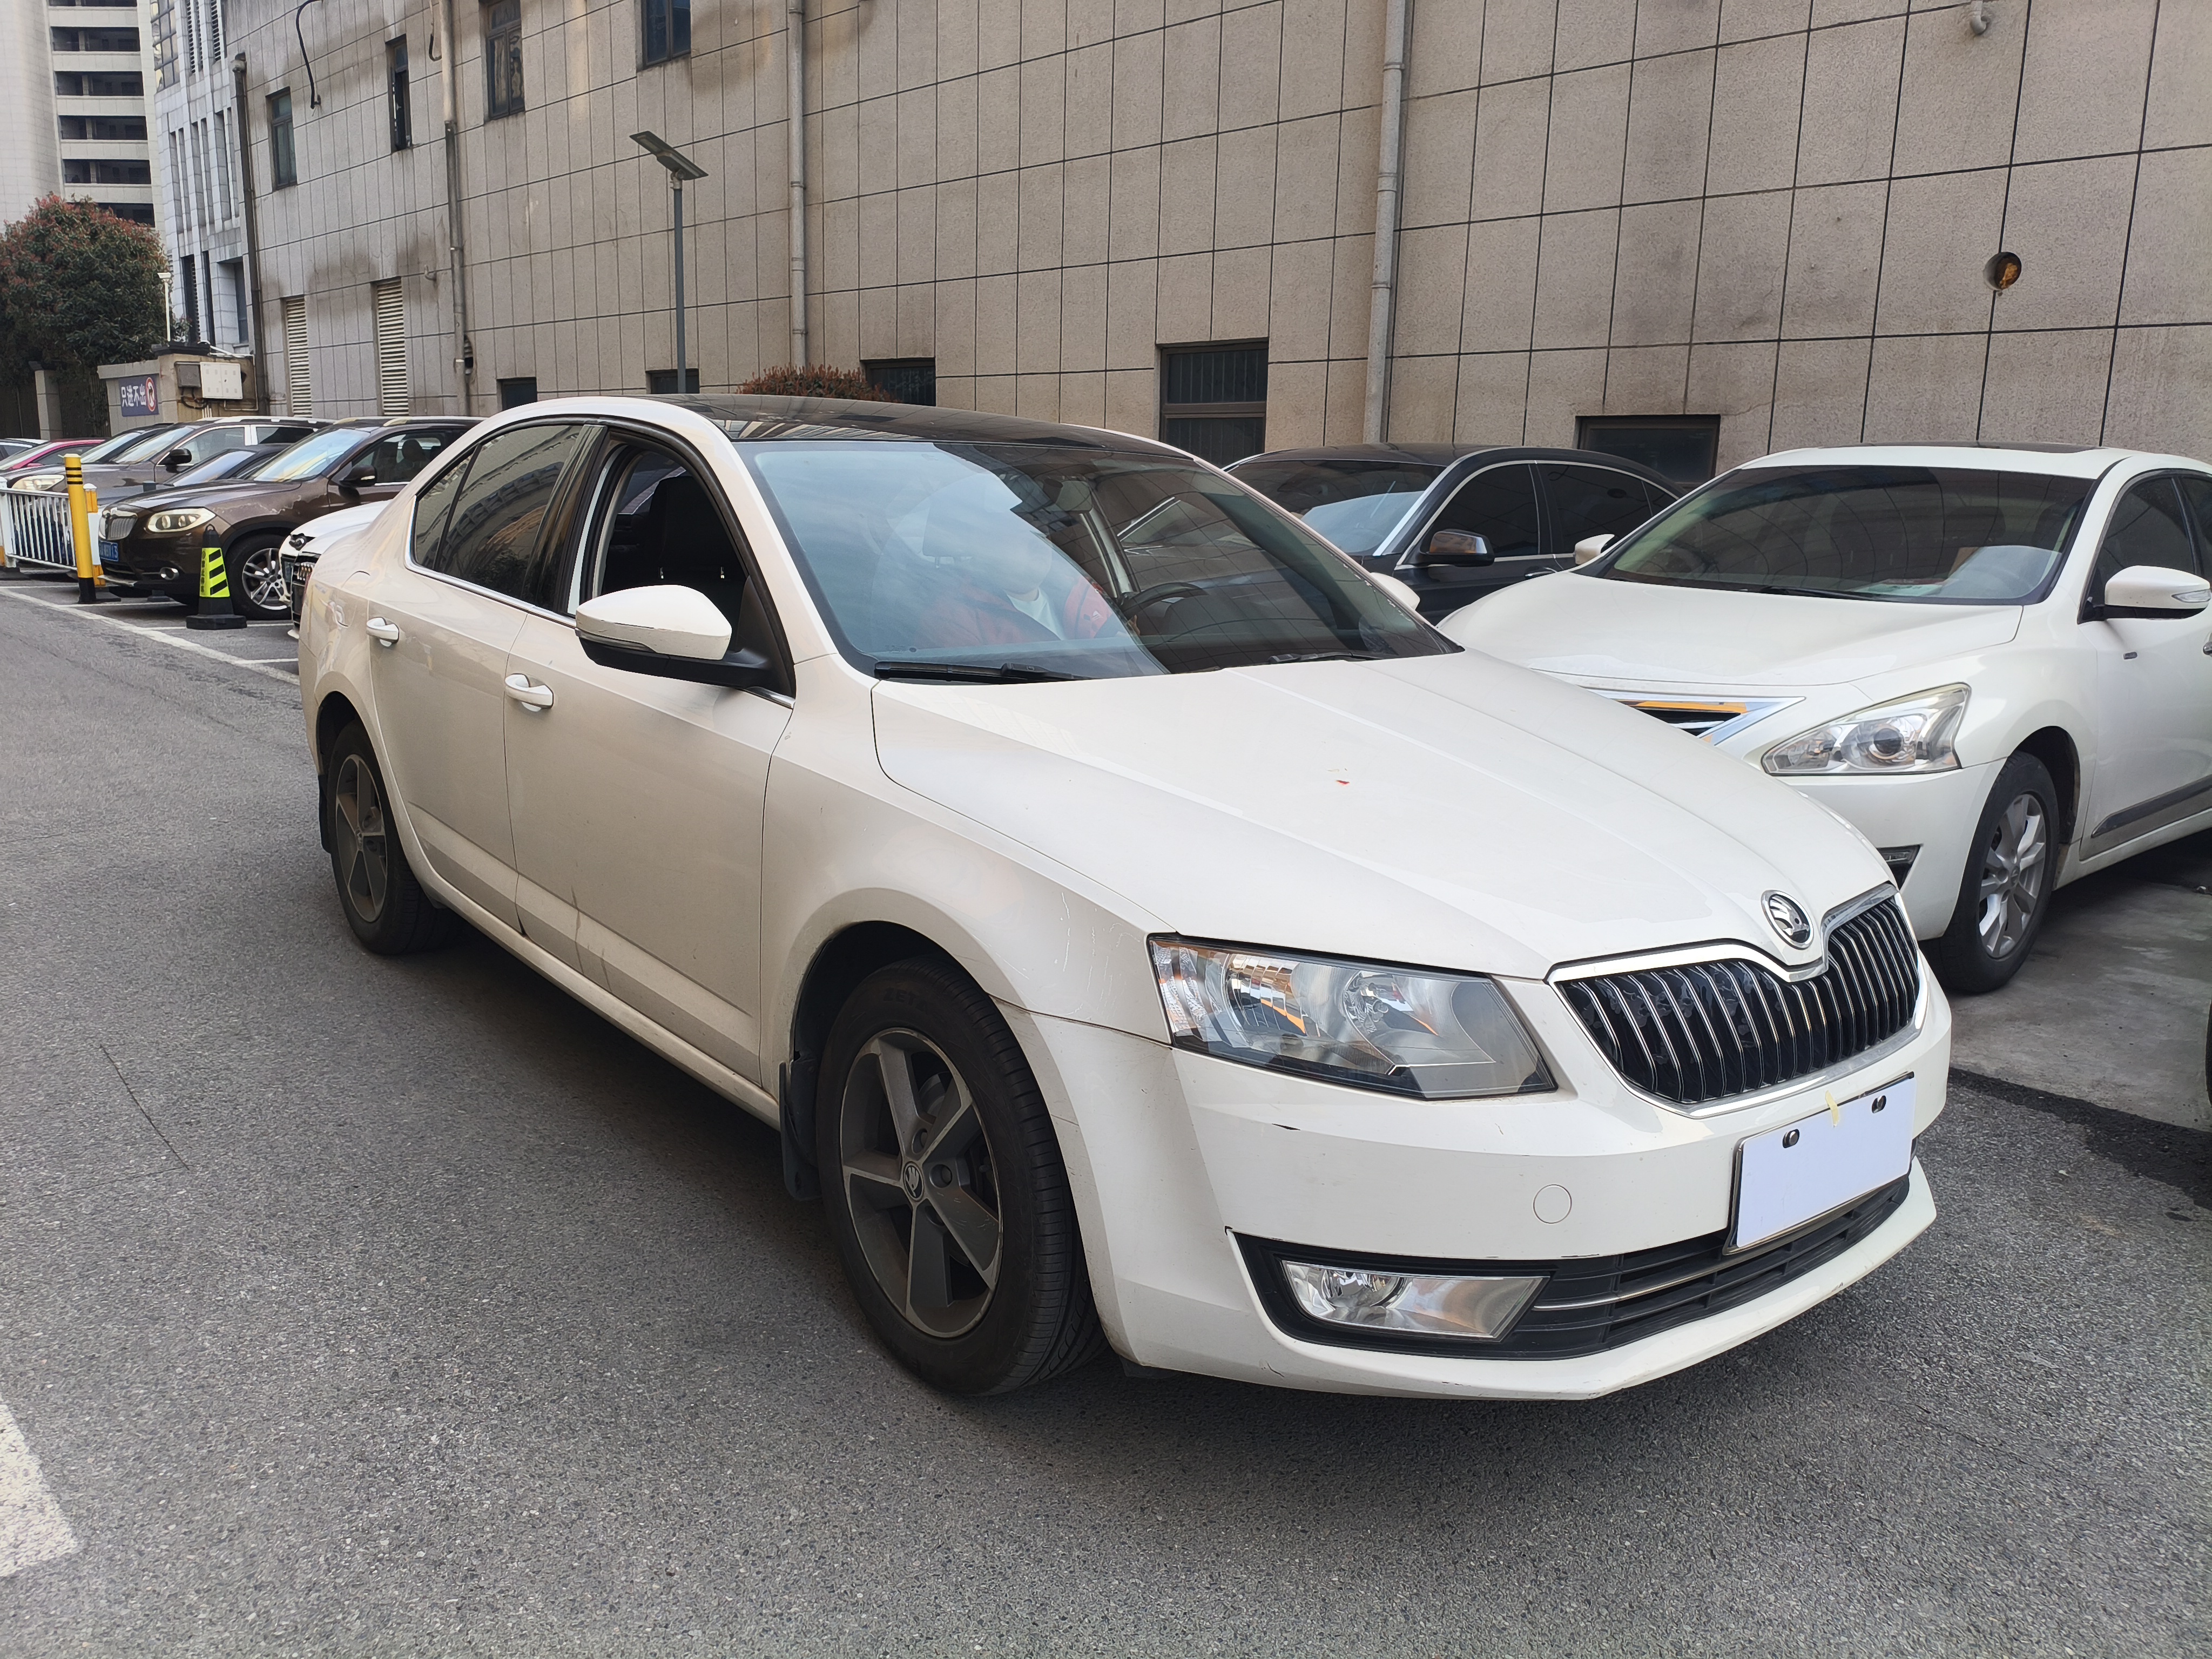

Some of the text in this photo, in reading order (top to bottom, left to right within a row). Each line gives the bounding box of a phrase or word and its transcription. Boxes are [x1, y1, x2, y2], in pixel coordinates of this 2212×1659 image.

[121, 383, 146, 407] 只进不出
[883, 987, 928, 1013] ZETA
